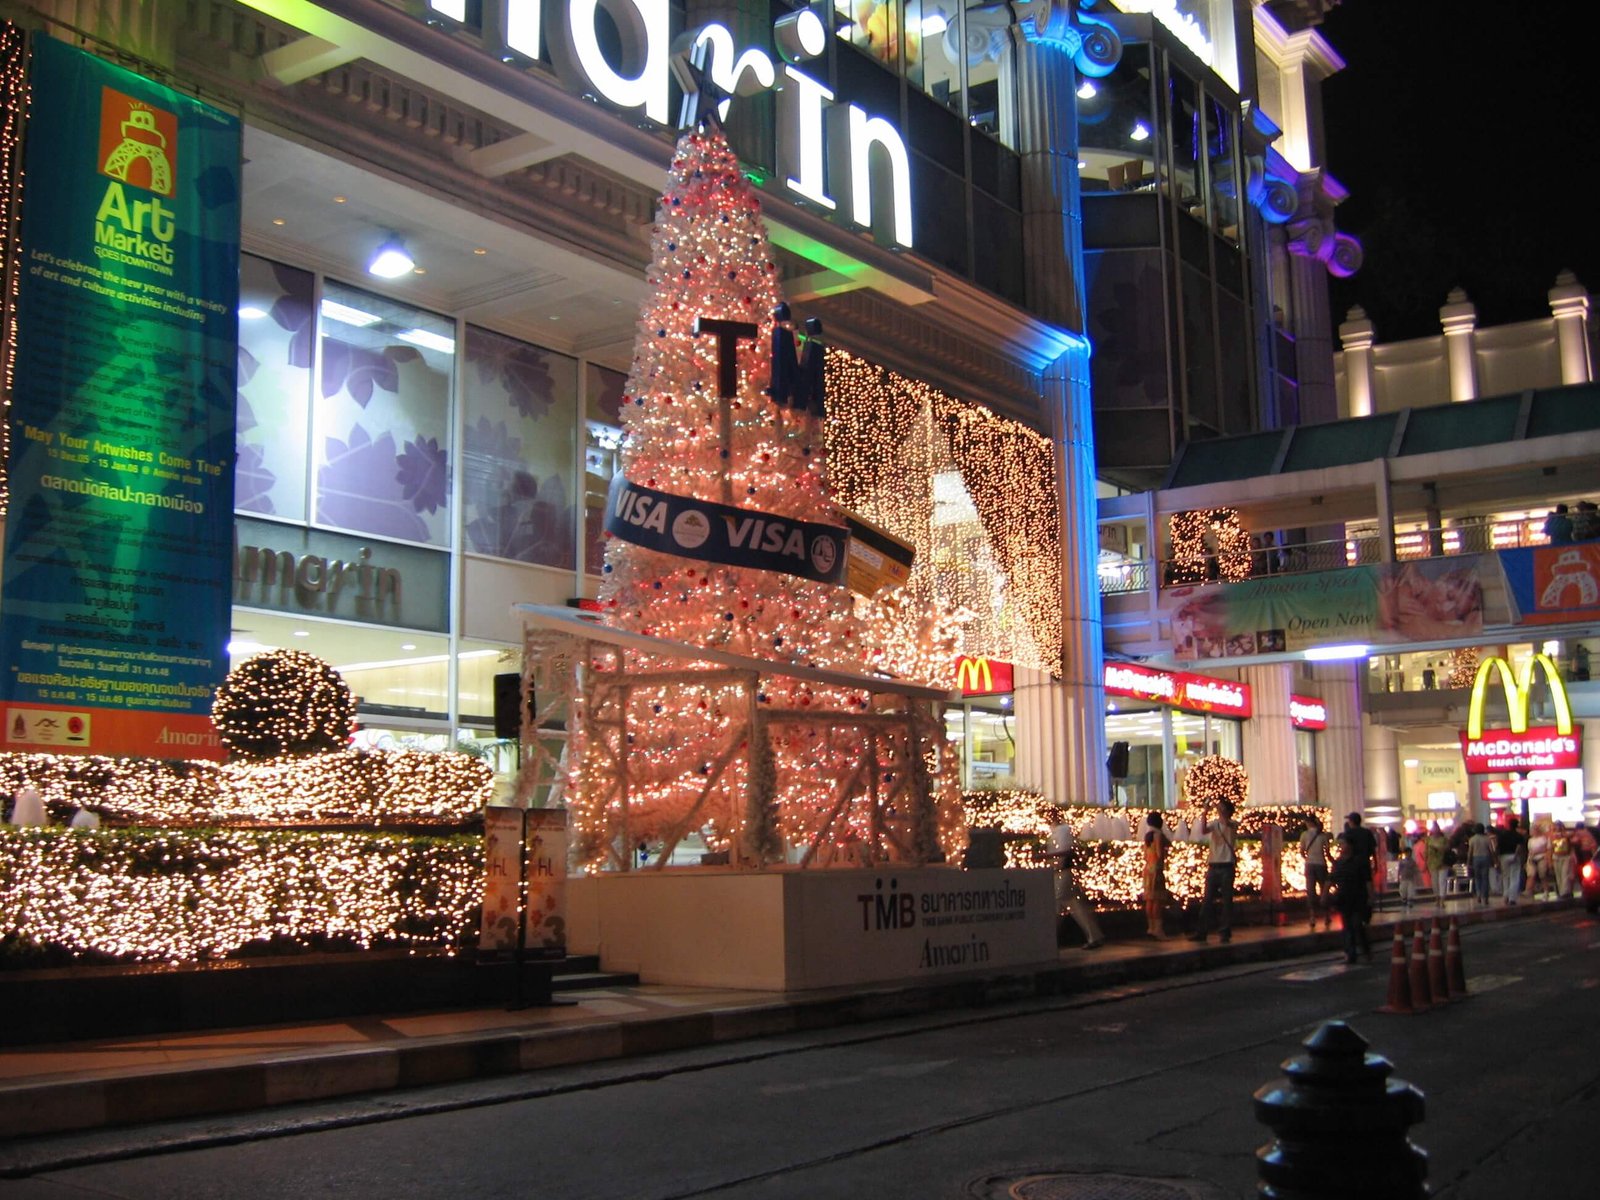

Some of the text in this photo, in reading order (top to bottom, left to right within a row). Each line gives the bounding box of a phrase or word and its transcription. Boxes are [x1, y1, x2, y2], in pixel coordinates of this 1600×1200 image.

[427, 0, 913, 249] arin
[96, 181, 175, 242] Art
[94, 246, 174, 276] GOES DOWNTOWN
[95, 221, 174, 264] Market
[30, 266, 206, 323] of art and culture activities including
[31, 249, 229, 315] Let's celebrate the new year with a variety
[59, 432, 89, 450] Your
[93, 440, 154, 463] Artwishes
[159, 451, 192, 470] Come
[99, 458, 109, 468] 15
[615, 489, 668, 535] VISA
[720, 514, 806, 561] VISA
[232, 545, 402, 606] marin
[1288, 611, 1374, 634] Open Now
[86, 693, 97, 702] 15
[1105, 666, 1174, 697] McDonald's
[1467, 738, 1576, 756] McDonald's
[857, 886, 916, 931] TMB
[921, 879, 1026, 914] ธนาคารทหารไทย
[919, 933, 990, 969] Amarin
